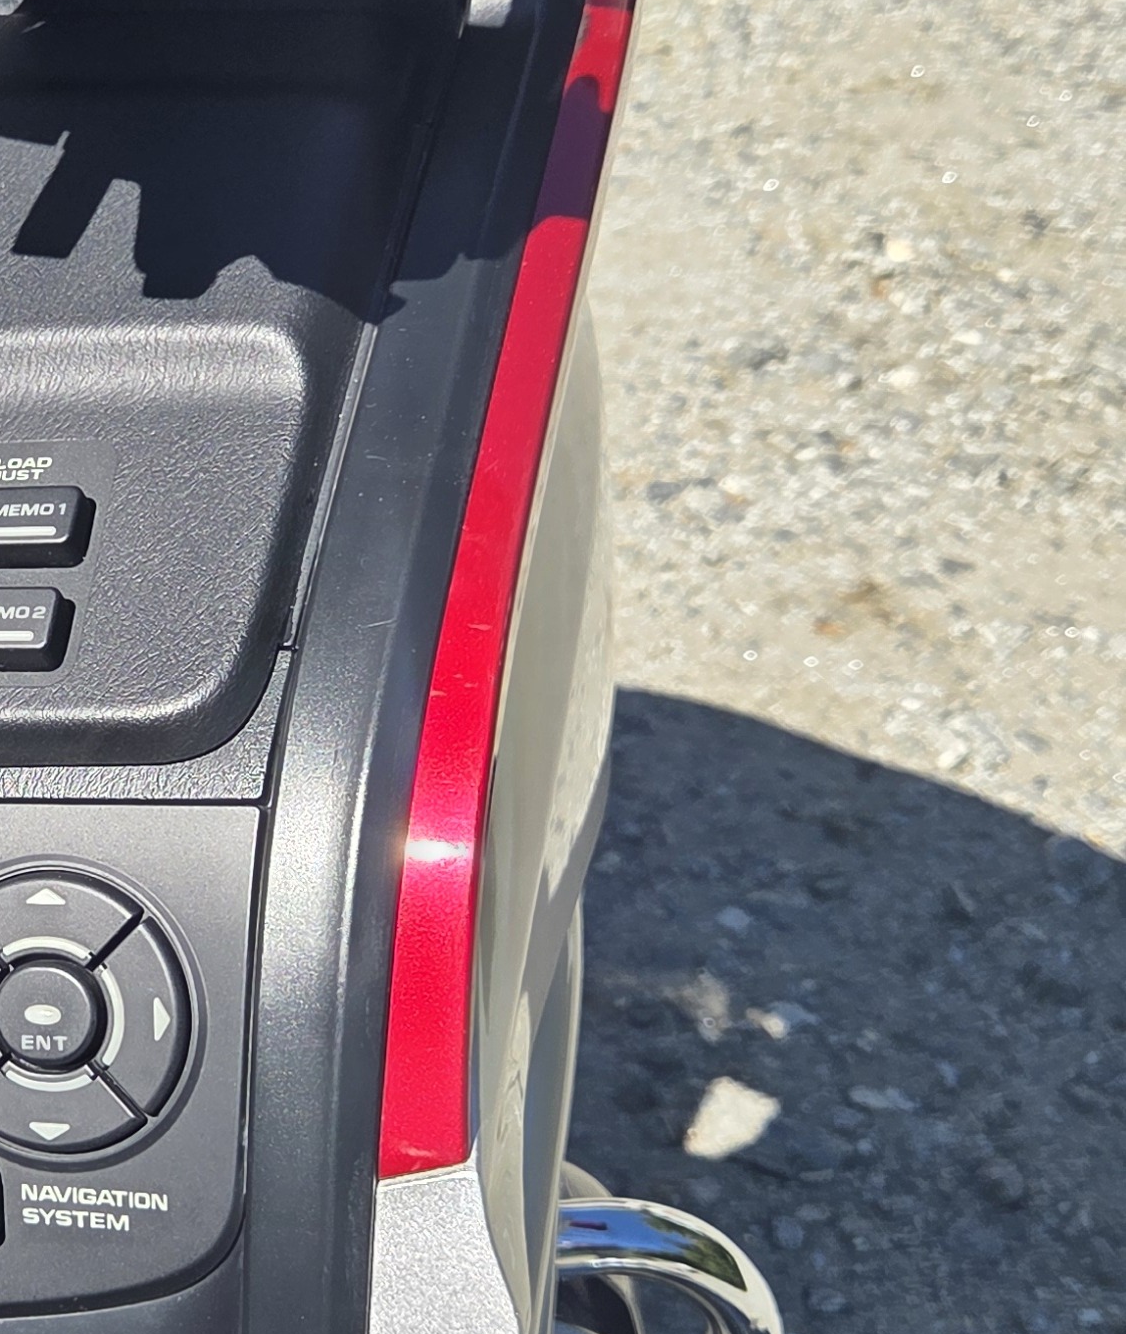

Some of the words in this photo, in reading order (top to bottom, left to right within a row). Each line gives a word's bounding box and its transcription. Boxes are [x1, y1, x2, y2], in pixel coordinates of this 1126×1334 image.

[20, 1035, 68, 1051] ENT
[20, 1183, 169, 1212] NAVIGATION
[22, 1208, 130, 1231] SYSTEM
